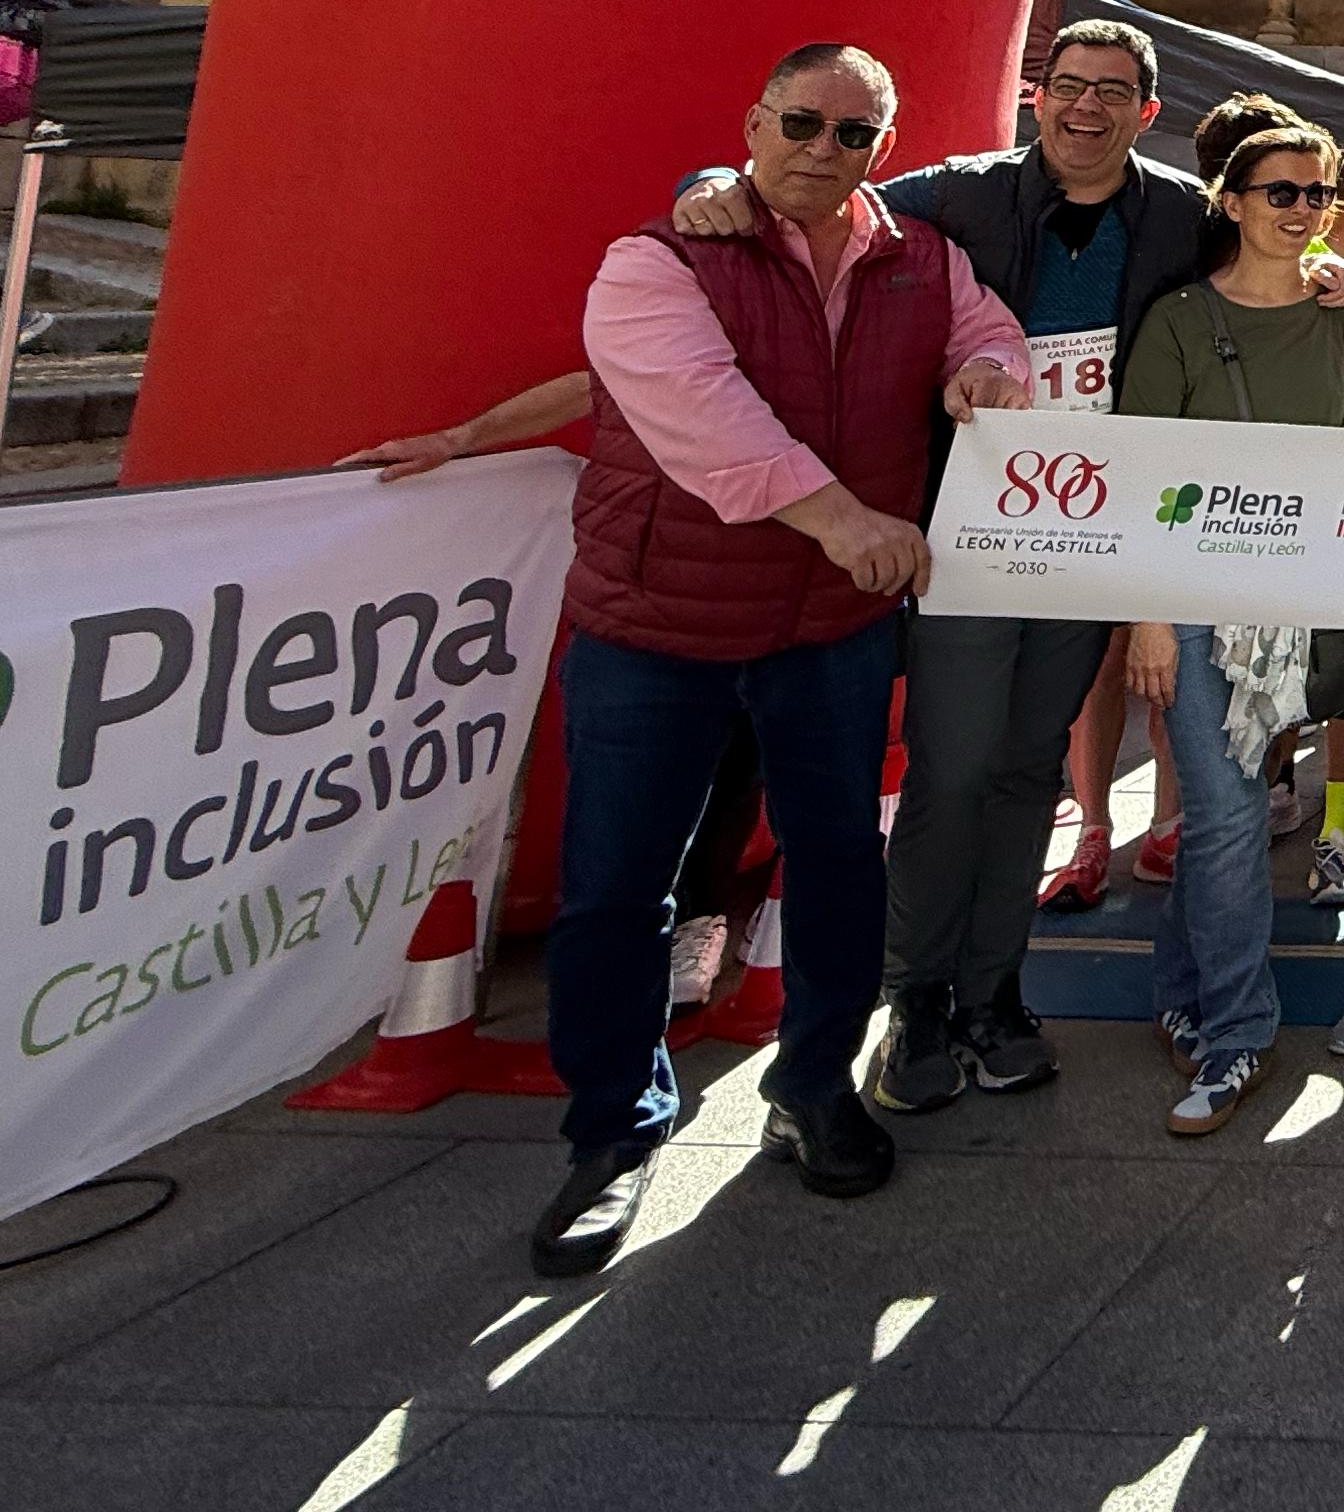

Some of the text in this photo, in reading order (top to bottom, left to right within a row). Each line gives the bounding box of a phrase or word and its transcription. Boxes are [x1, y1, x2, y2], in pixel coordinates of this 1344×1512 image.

[1031, 341, 1050, 351] DÍA
[1052, 340, 1066, 349] DE
[1069, 338, 1082, 347] LA
[1047, 347, 1096, 359] CASTILLA
[1040, 357, 1114, 400] 18
[1207, 484, 1304, 518] Plena
[959, 524, 1124, 541] Aniversario Unión de los Reinos de
[1201, 514, 1298, 537] inclusión
[955, 534, 1118, 555] LEÓN Y CASTILLA
[1196, 538, 1306, 558] Castilla y León
[1006, 561, 1048, 576] 2030
[56, 577, 518, 789] Plena
[39, 699, 507, 926] inclusión
[19, 884, 327, 1057] Castilla
[344, 863, 387, 946] y
